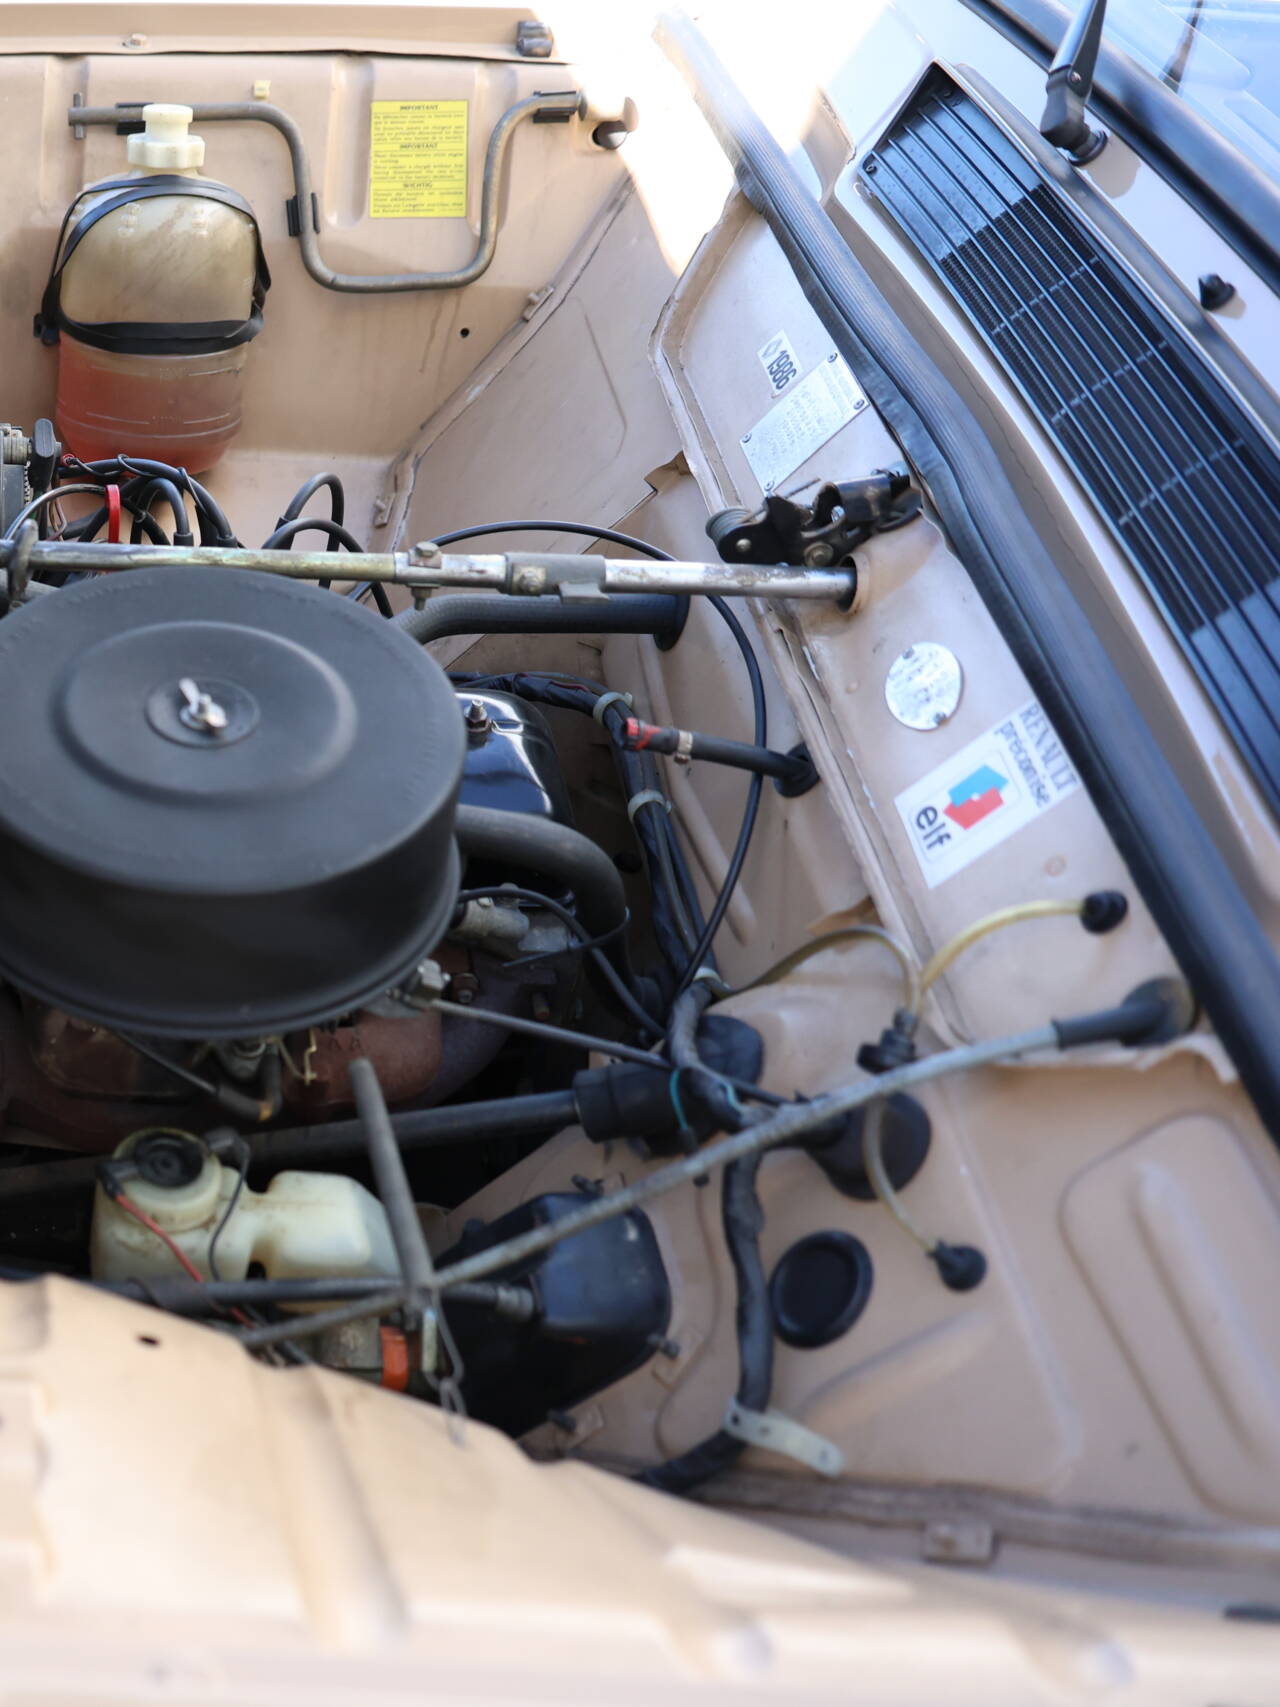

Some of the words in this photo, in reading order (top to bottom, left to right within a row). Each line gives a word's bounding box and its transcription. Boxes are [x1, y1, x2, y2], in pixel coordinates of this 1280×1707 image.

[767, 350, 797, 390] 1986
[1021, 701, 1077, 790] RENAULT
[916, 805, 951, 850] elf
